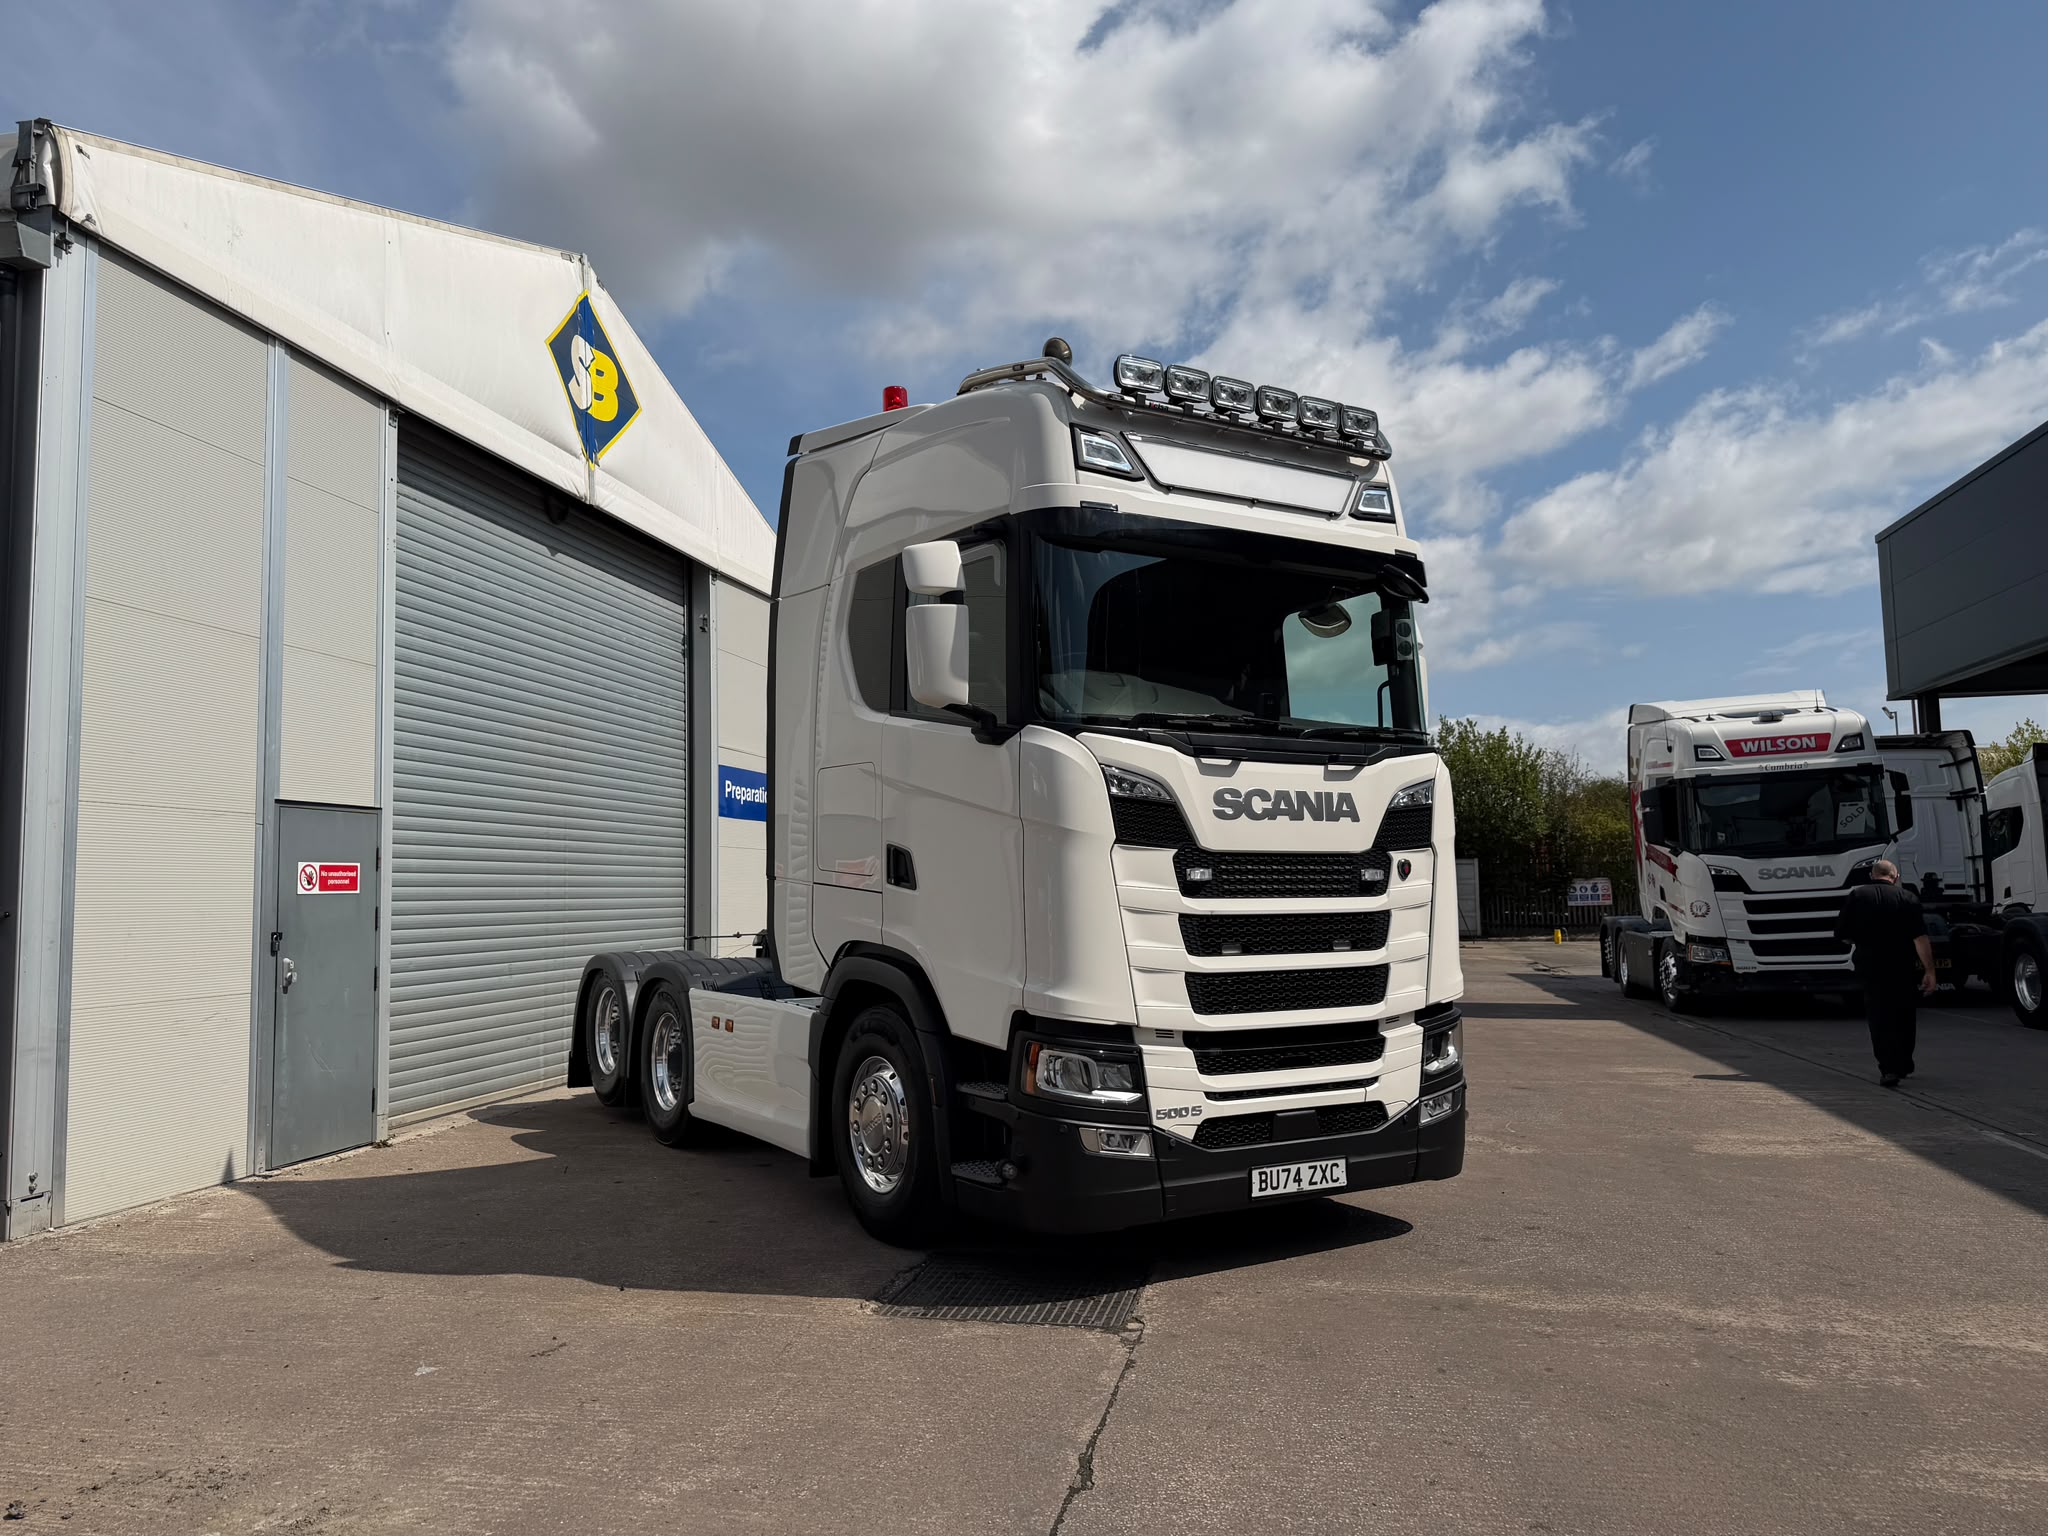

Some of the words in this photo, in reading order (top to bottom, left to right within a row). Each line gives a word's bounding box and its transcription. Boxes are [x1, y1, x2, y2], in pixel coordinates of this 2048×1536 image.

[1741, 736, 1816, 754] WILSON
[1764, 762, 1803, 772] Cumbria
[1212, 788, 1360, 822] SCANIA
[1840, 806, 1865, 828] SOLD
[1758, 864, 1835, 880] SCANIA
[328, 878, 350, 886] personnel
[1156, 1107, 1189, 1120] 500
[1258, 1166, 1303, 1192] BU74
[1308, 1162, 1340, 1186] ZXC
